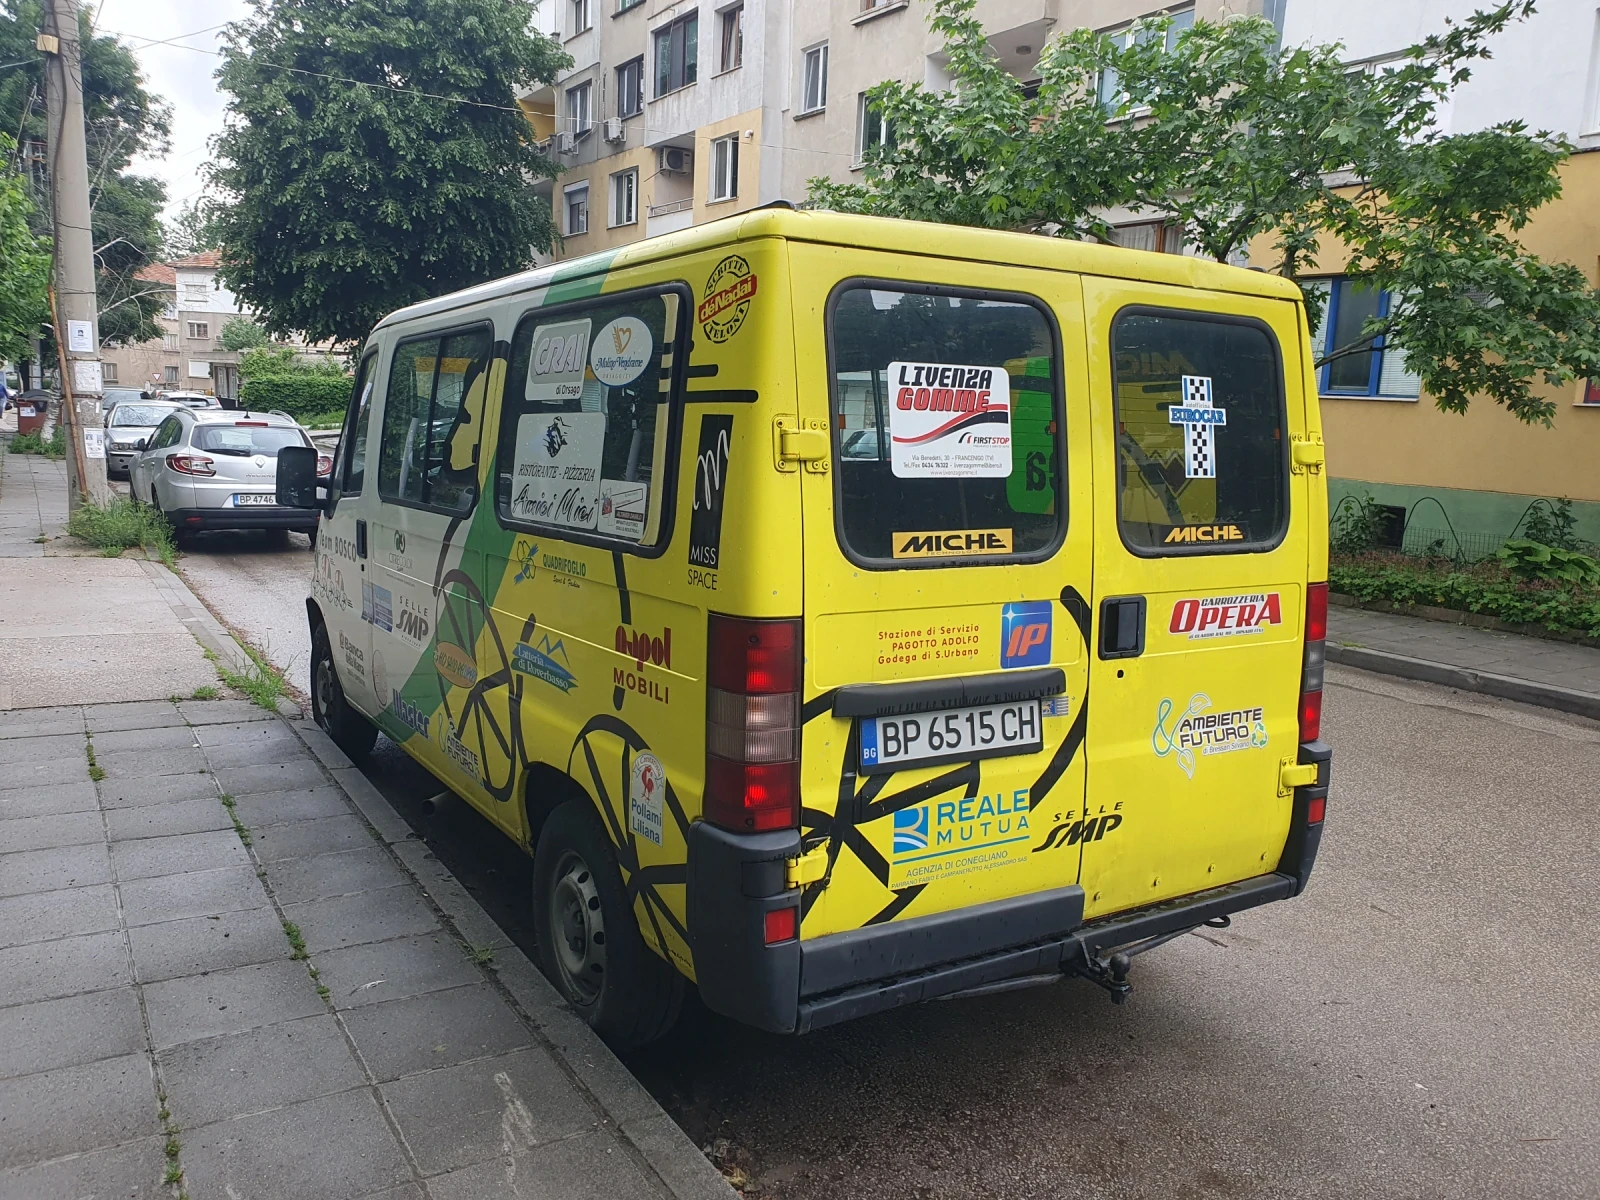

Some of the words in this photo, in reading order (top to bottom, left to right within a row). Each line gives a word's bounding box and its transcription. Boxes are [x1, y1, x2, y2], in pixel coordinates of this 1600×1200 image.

[708, 260, 744, 292] SCRITTE
[534, 334, 586, 376] CRAI
[556, 385, 561, 395] di
[562, 383, 580, 396] Orsago
[898, 366, 992, 390] LIVENZA
[896, 388, 990, 412] GOMME
[1171, 408, 1225, 424] EUROCAR
[518, 464, 559, 479] RISTORANTE
[562, 467, 596, 482] PIZZERIA
[253, 495, 274, 504] 4746
[513, 484, 556, 518] Amici
[321, 529, 332, 551] Team
[335, 536, 357, 562] BOSCO
[899, 534, 1007, 553] MICHE
[1164, 525, 1243, 542] MICHE
[543, 554, 586, 577] QUADRIFOGLIO
[690, 545, 716, 565] MISS
[688, 569, 717, 590] SPACE
[400, 596, 428, 616] SELLE
[1201, 595, 1264, 606] CARROZZERIA
[396, 609, 428, 642] SMP
[1170, 594, 1282, 633] OPERA
[878, 628, 922, 640] Stazione
[927, 627, 936, 636] di
[940, 624, 979, 635] Servizio
[892, 639, 937, 651] PAGOTTO
[941, 635, 979, 645] ADOLFO
[1006, 623, 1048, 657] IP
[344, 636, 364, 661] Banca
[518, 646, 544, 666] Latteria
[878, 654, 917, 664] Godega
[921, 651, 931, 660] di
[935, 648, 979, 659] S.Urbano
[518, 659, 525, 670] di
[527, 661, 568, 689] Roverbasso
[613, 667, 669, 704] MOBILI
[393, 688, 430, 739] Master
[1180, 708, 1262, 733] AMBIENTE
[882, 719, 921, 758] BP
[928, 710, 995, 751] 6515
[1001, 706, 1035, 741] CH
[1180, 725, 1249, 748] FUTURO
[448, 748, 474, 773] FUTURO
[863, 747, 876, 759] BG
[1209, 744, 1230, 753] Bressan
[632, 798, 662, 827] Pollami
[938, 788, 1029, 826] REALE
[1053, 802, 1123, 822] SELLE
[633, 816, 660, 844] Liliana
[937, 816, 1029, 845] MUTUA
[1032, 814, 1122, 853] SMP
[906, 865, 942, 878] AGENZIA
[955, 851, 1008, 868] CONEGLIANO
[984, 858, 1016, 869] ALESSANDRO
